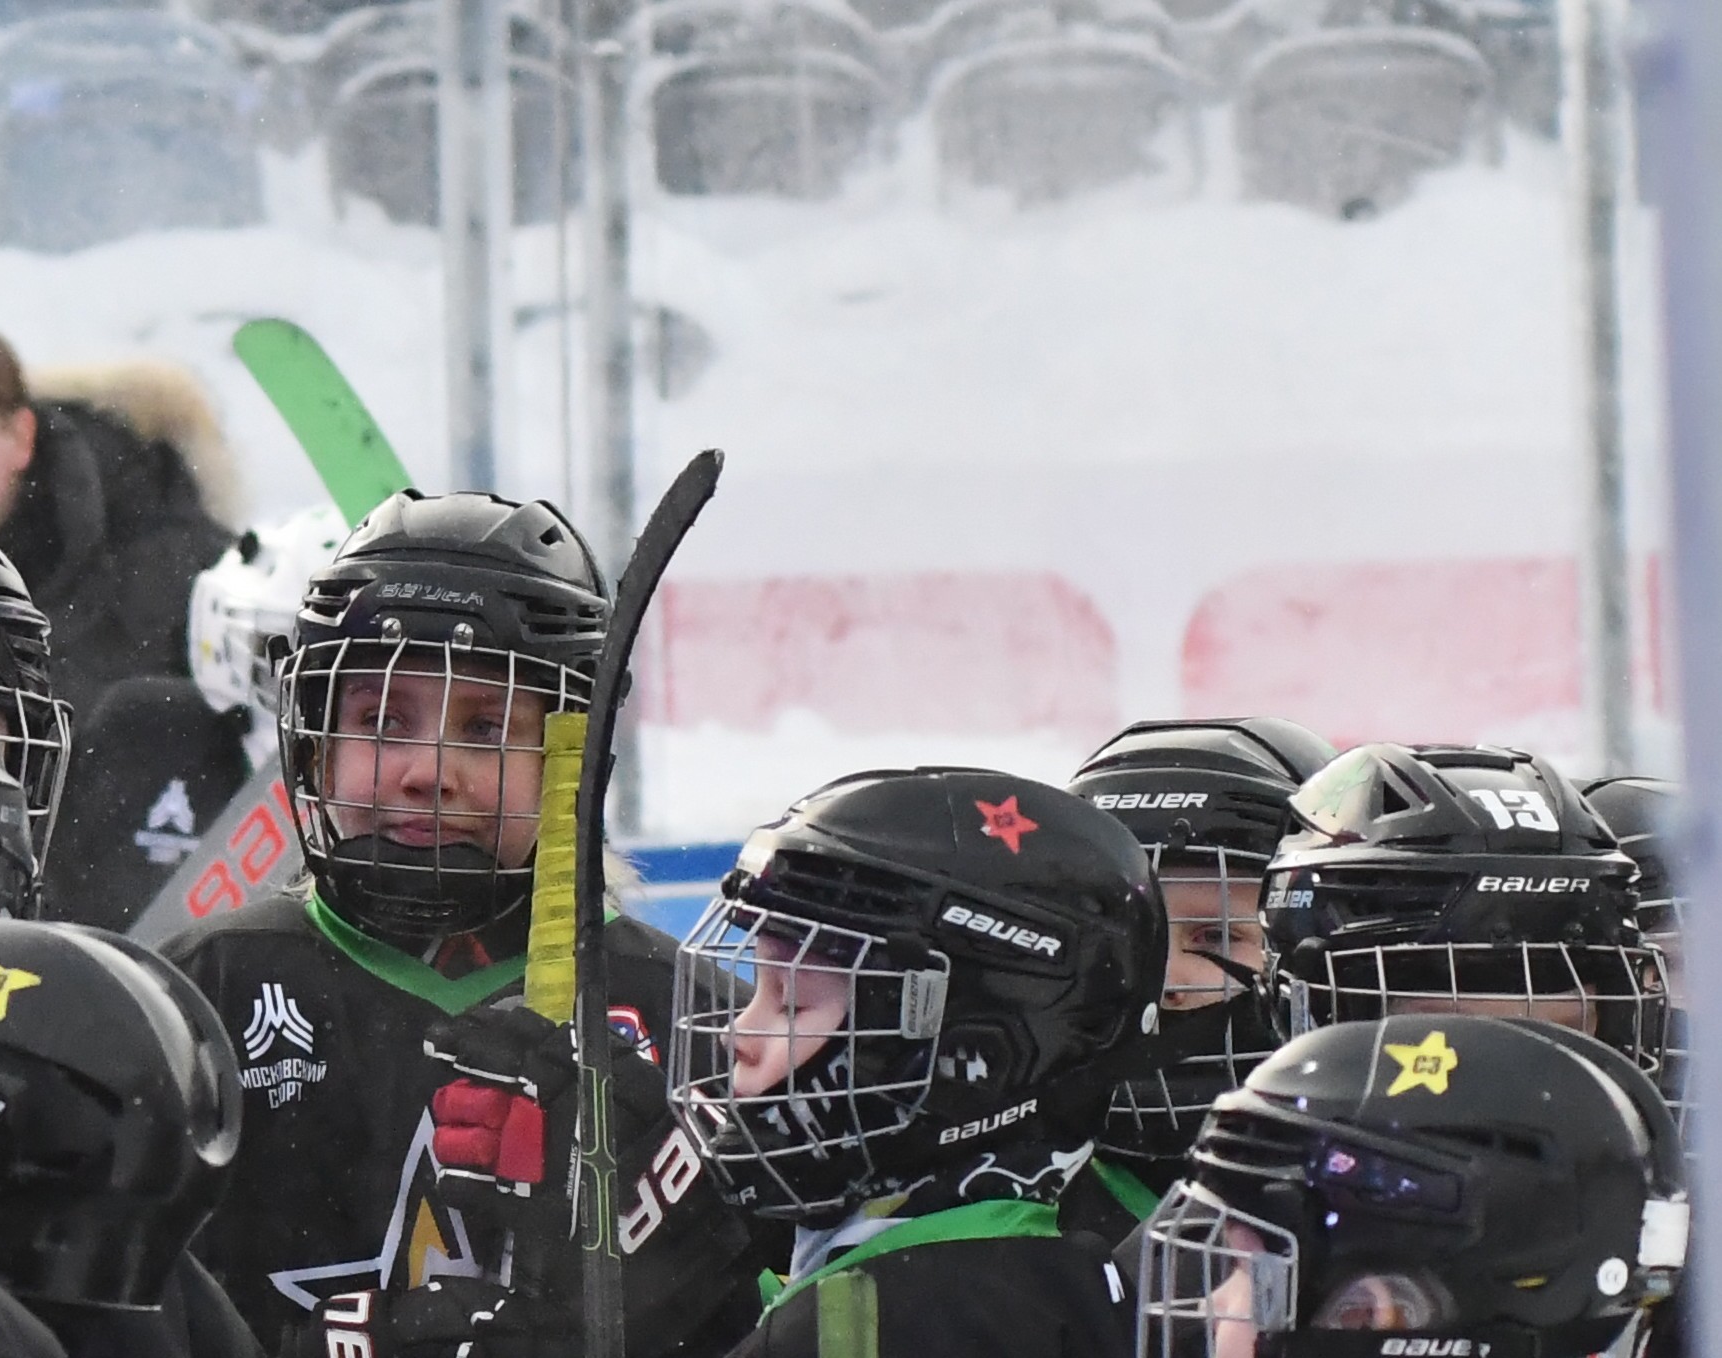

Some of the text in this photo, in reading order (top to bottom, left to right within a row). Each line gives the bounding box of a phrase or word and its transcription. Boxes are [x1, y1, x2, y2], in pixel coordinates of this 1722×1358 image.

[1096, 792, 1209, 810] BAUER
[1469, 789, 1559, 832] 13
[1477, 876, 1591, 893] BAUER
[942, 906, 1062, 957] BAUER
[939, 1099, 1037, 1145] BAUER
